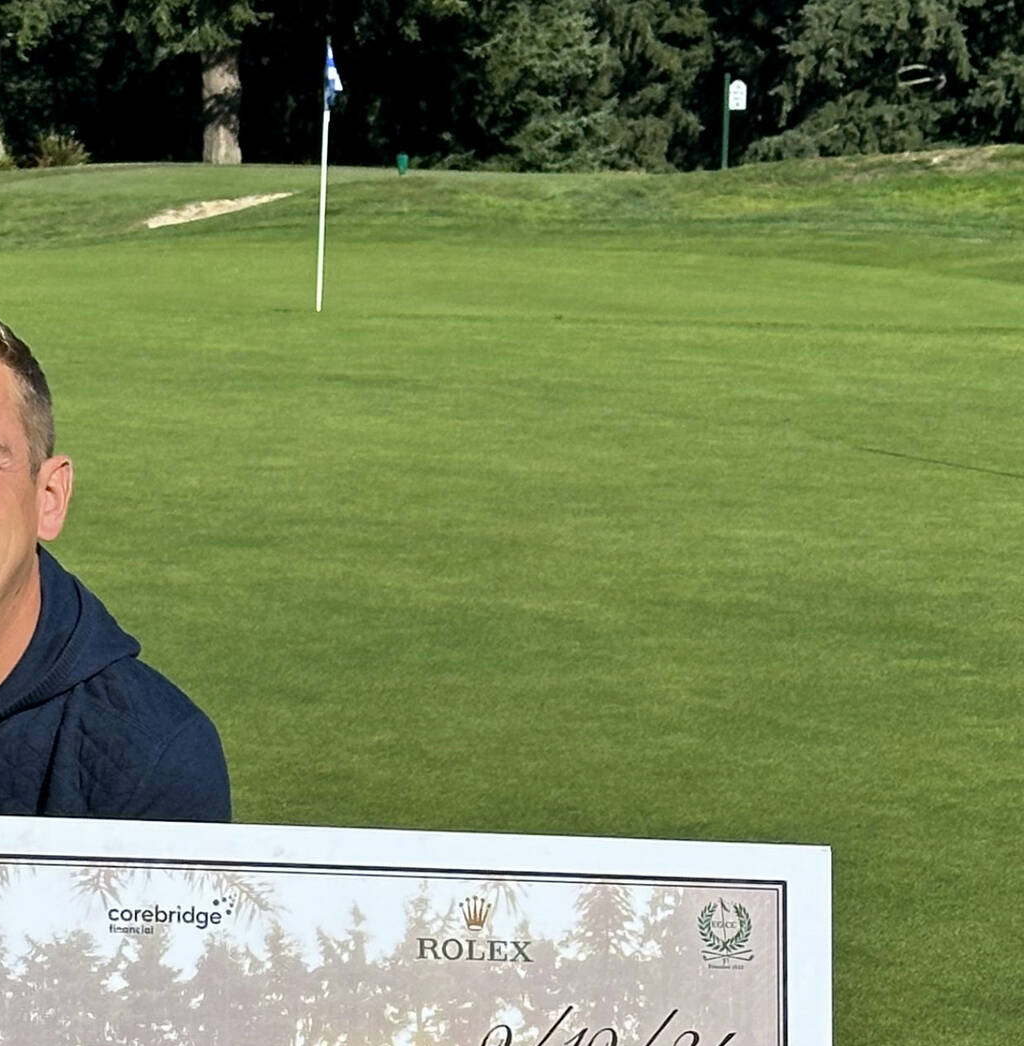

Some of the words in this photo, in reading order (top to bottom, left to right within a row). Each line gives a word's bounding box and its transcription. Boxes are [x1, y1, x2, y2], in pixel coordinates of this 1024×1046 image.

[108, 904, 223, 930] corebridge
[109, 923, 155, 935] financial
[415, 937, 534, 963] ROLEX
